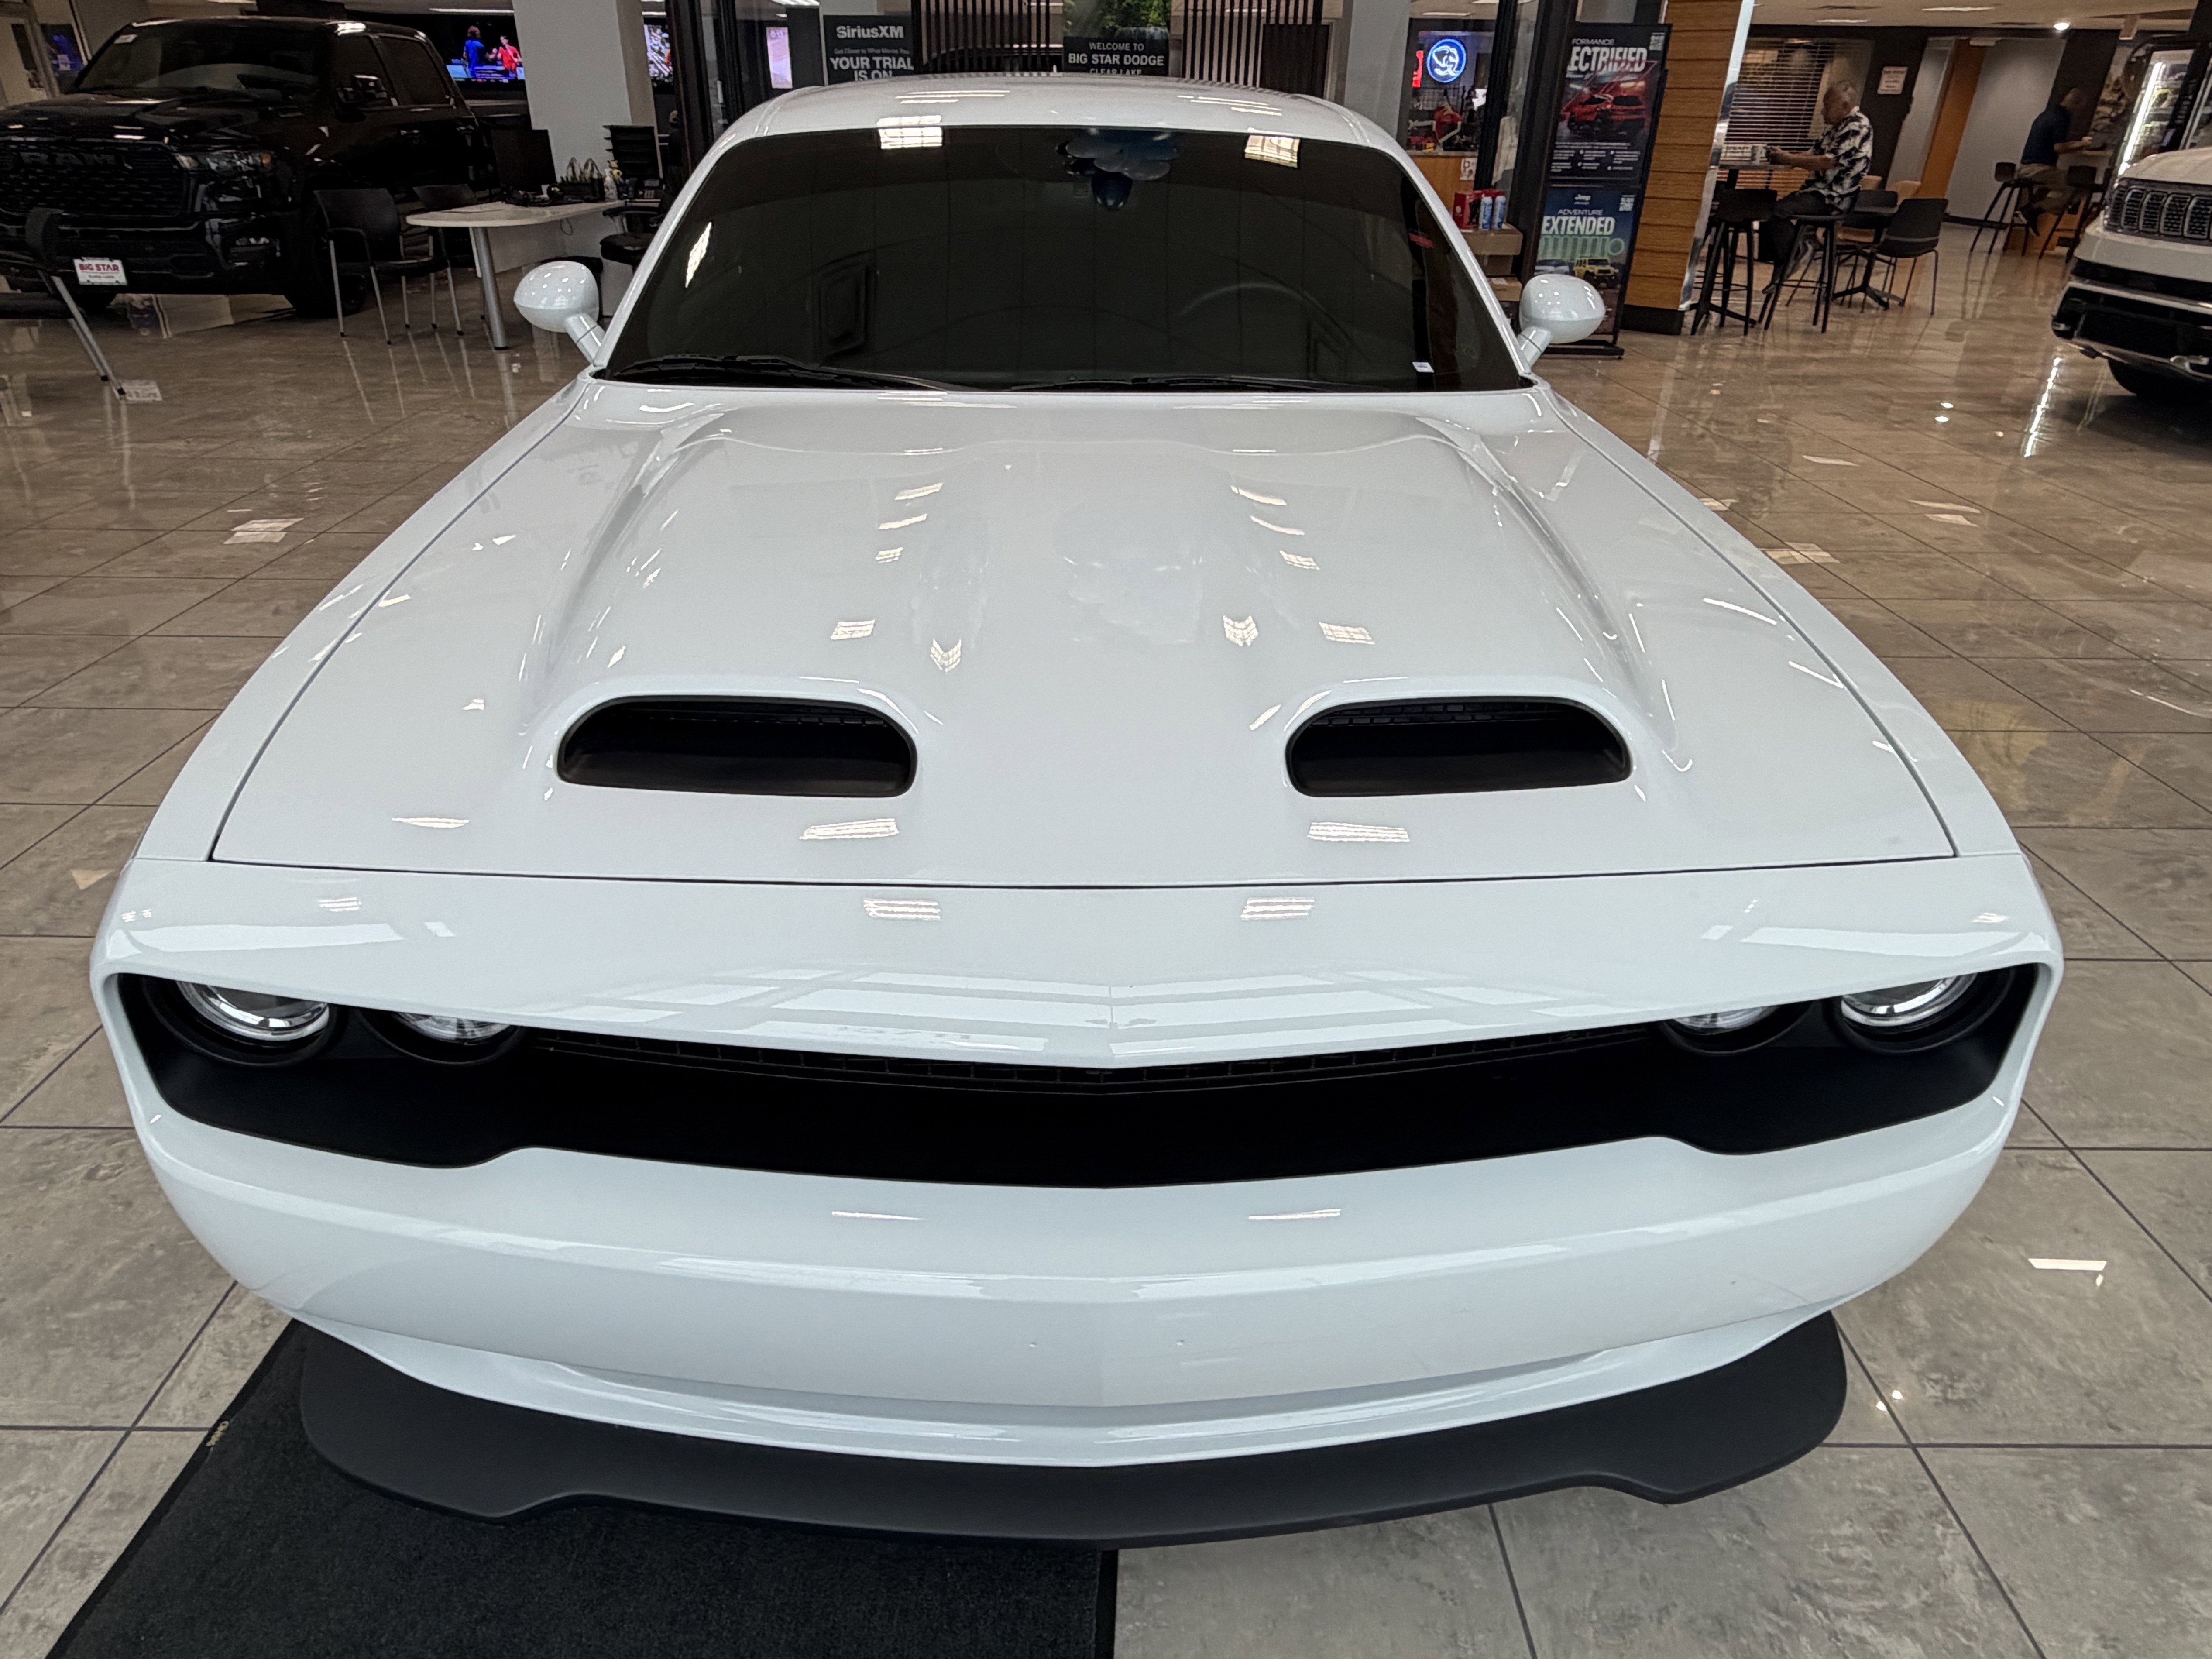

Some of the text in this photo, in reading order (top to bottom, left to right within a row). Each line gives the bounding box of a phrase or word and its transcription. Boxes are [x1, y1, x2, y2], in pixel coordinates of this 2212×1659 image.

[836, 25, 904, 38] SiriusXM
[1089, 42, 1144, 51] WELCOME TO
[830, 57, 914, 70] YOUR TRIAL
[1068, 53, 1164, 66] BIG STAR DODGE
[1567, 46, 1647, 72] ECTRIFIED
[854, 70, 893, 82] IS ON
[20, 152, 117, 166] RAM
[1541, 216, 1616, 235] EXTENDED
[95, 263, 119, 271] STAR
